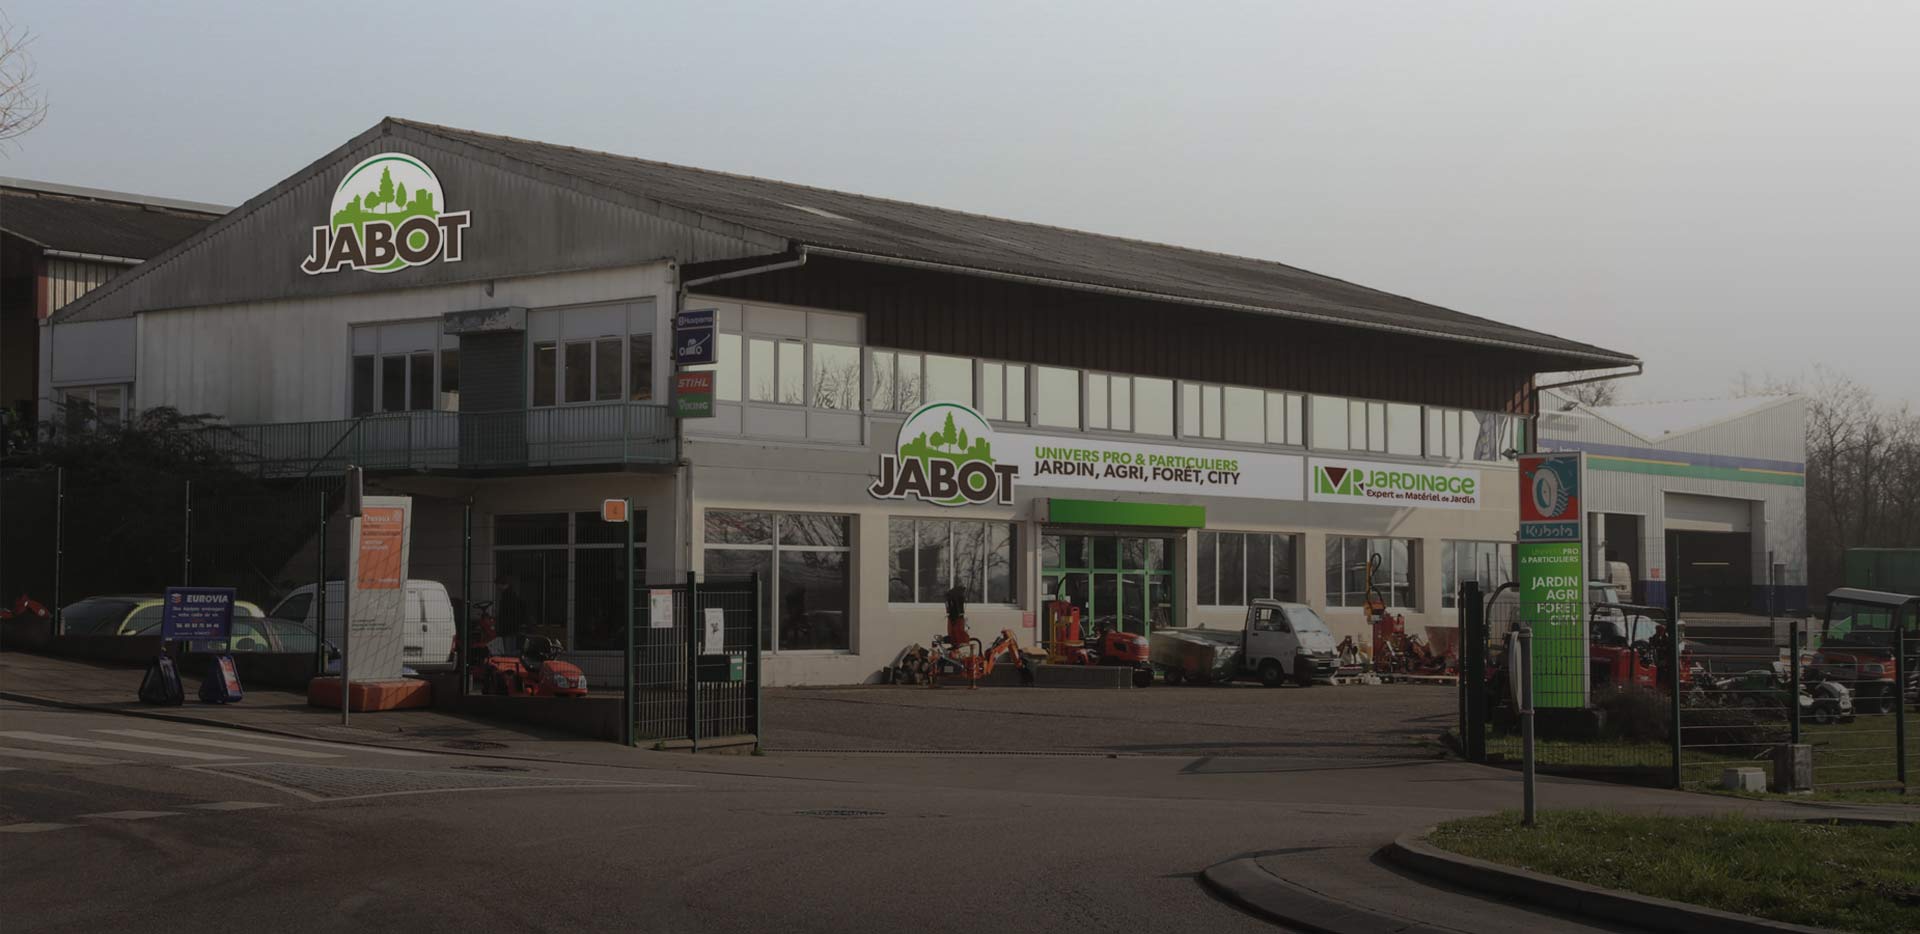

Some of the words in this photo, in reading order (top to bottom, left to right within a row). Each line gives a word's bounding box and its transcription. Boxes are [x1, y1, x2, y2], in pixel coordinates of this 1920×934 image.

[301, 213, 469, 274] JABOT
[677, 378, 709, 388] STIHL
[1034, 446, 1100, 462] UNIVERS
[1103, 451, 1132, 465] PRO
[1136, 453, 1146, 466] &
[1149, 454, 1238, 472] PARTICULIERS
[870, 455, 1019, 503] JABOT
[1034, 460, 1101, 479] JARDIN,
[1104, 464, 1149, 482] AGRI,
[1152, 466, 1205, 485] FORÊT,
[1207, 471, 1241, 485] CITY
[1366, 488, 1394, 498] Expert
[1405, 491, 1440, 502] Matériel
[1451, 495, 1476, 503] Jardin
[1525, 524, 1573, 537] Kubota
[1531, 576, 1579, 590] JARDIN
[186, 594, 229, 603] EUROVIA
[1546, 589, 1579, 600] AGRI
